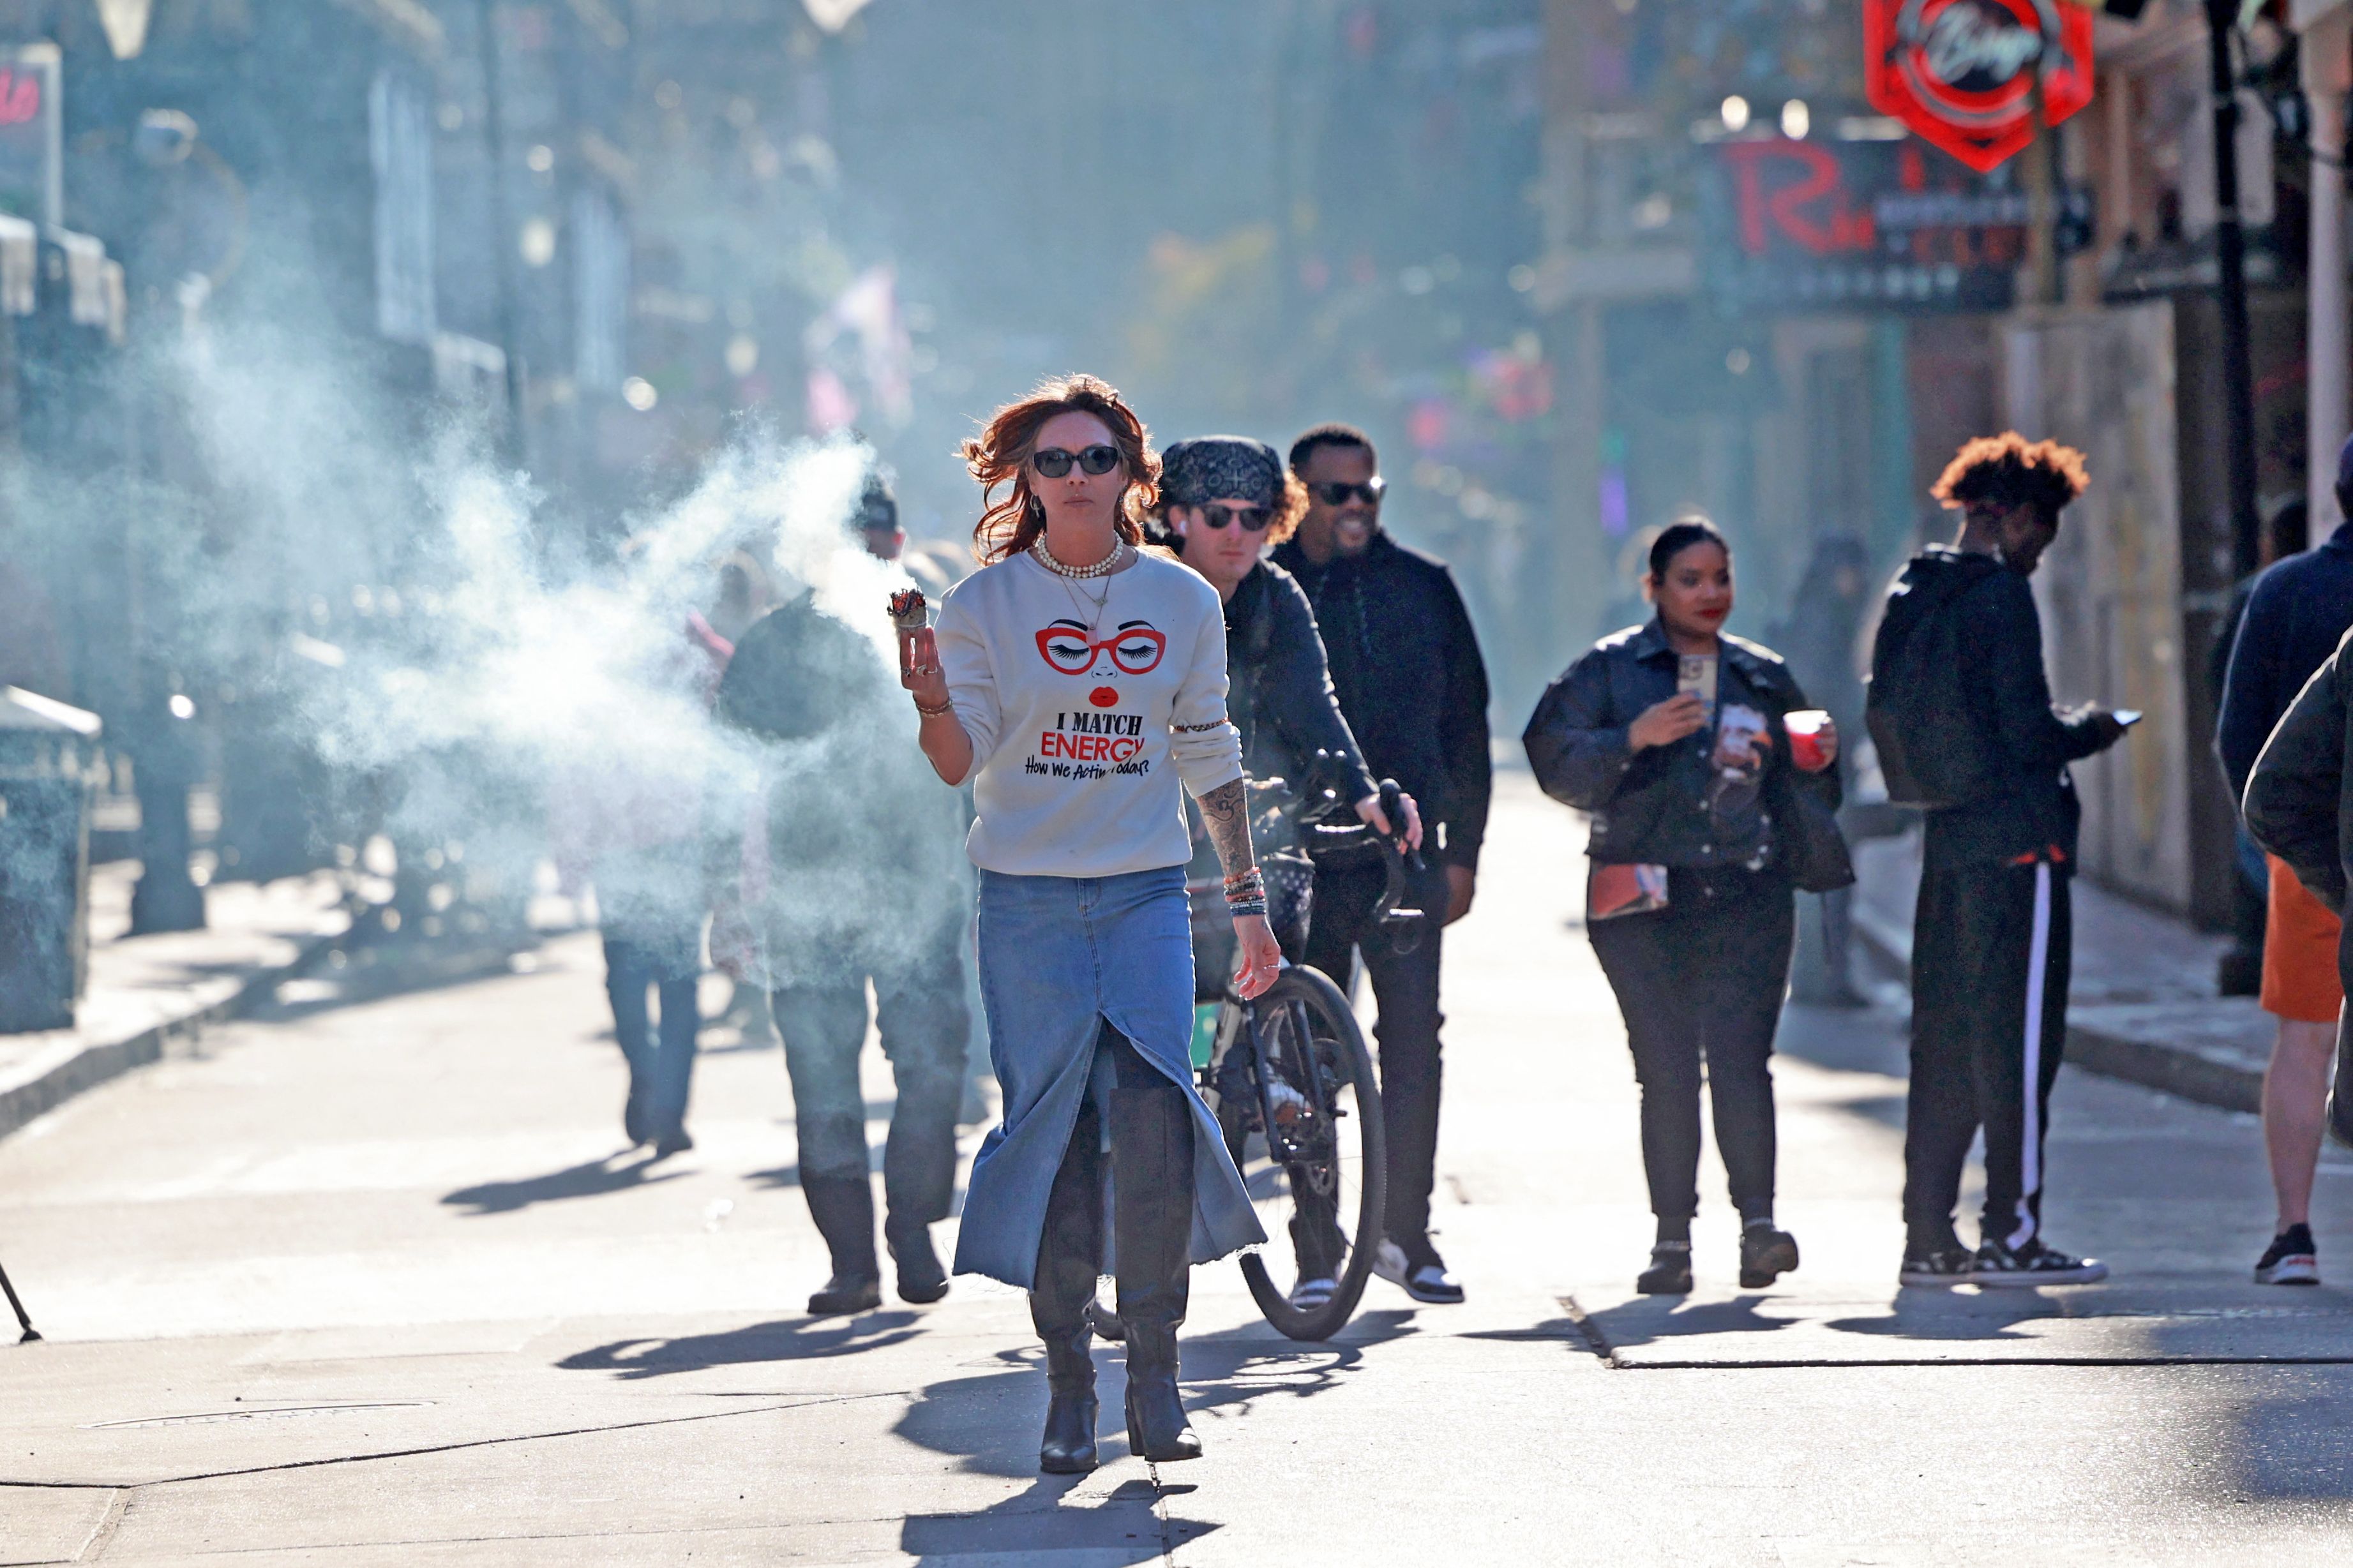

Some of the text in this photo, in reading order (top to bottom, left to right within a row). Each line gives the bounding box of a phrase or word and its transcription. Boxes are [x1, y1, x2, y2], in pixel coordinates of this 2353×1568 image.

[1056, 712, 1143, 736] I MATCH
[1041, 731, 1145, 762] ENERGY
[1025, 754, 1048, 775] How
[1052, 762, 1071, 777] We
[1111, 758, 1149, 777] oday?
